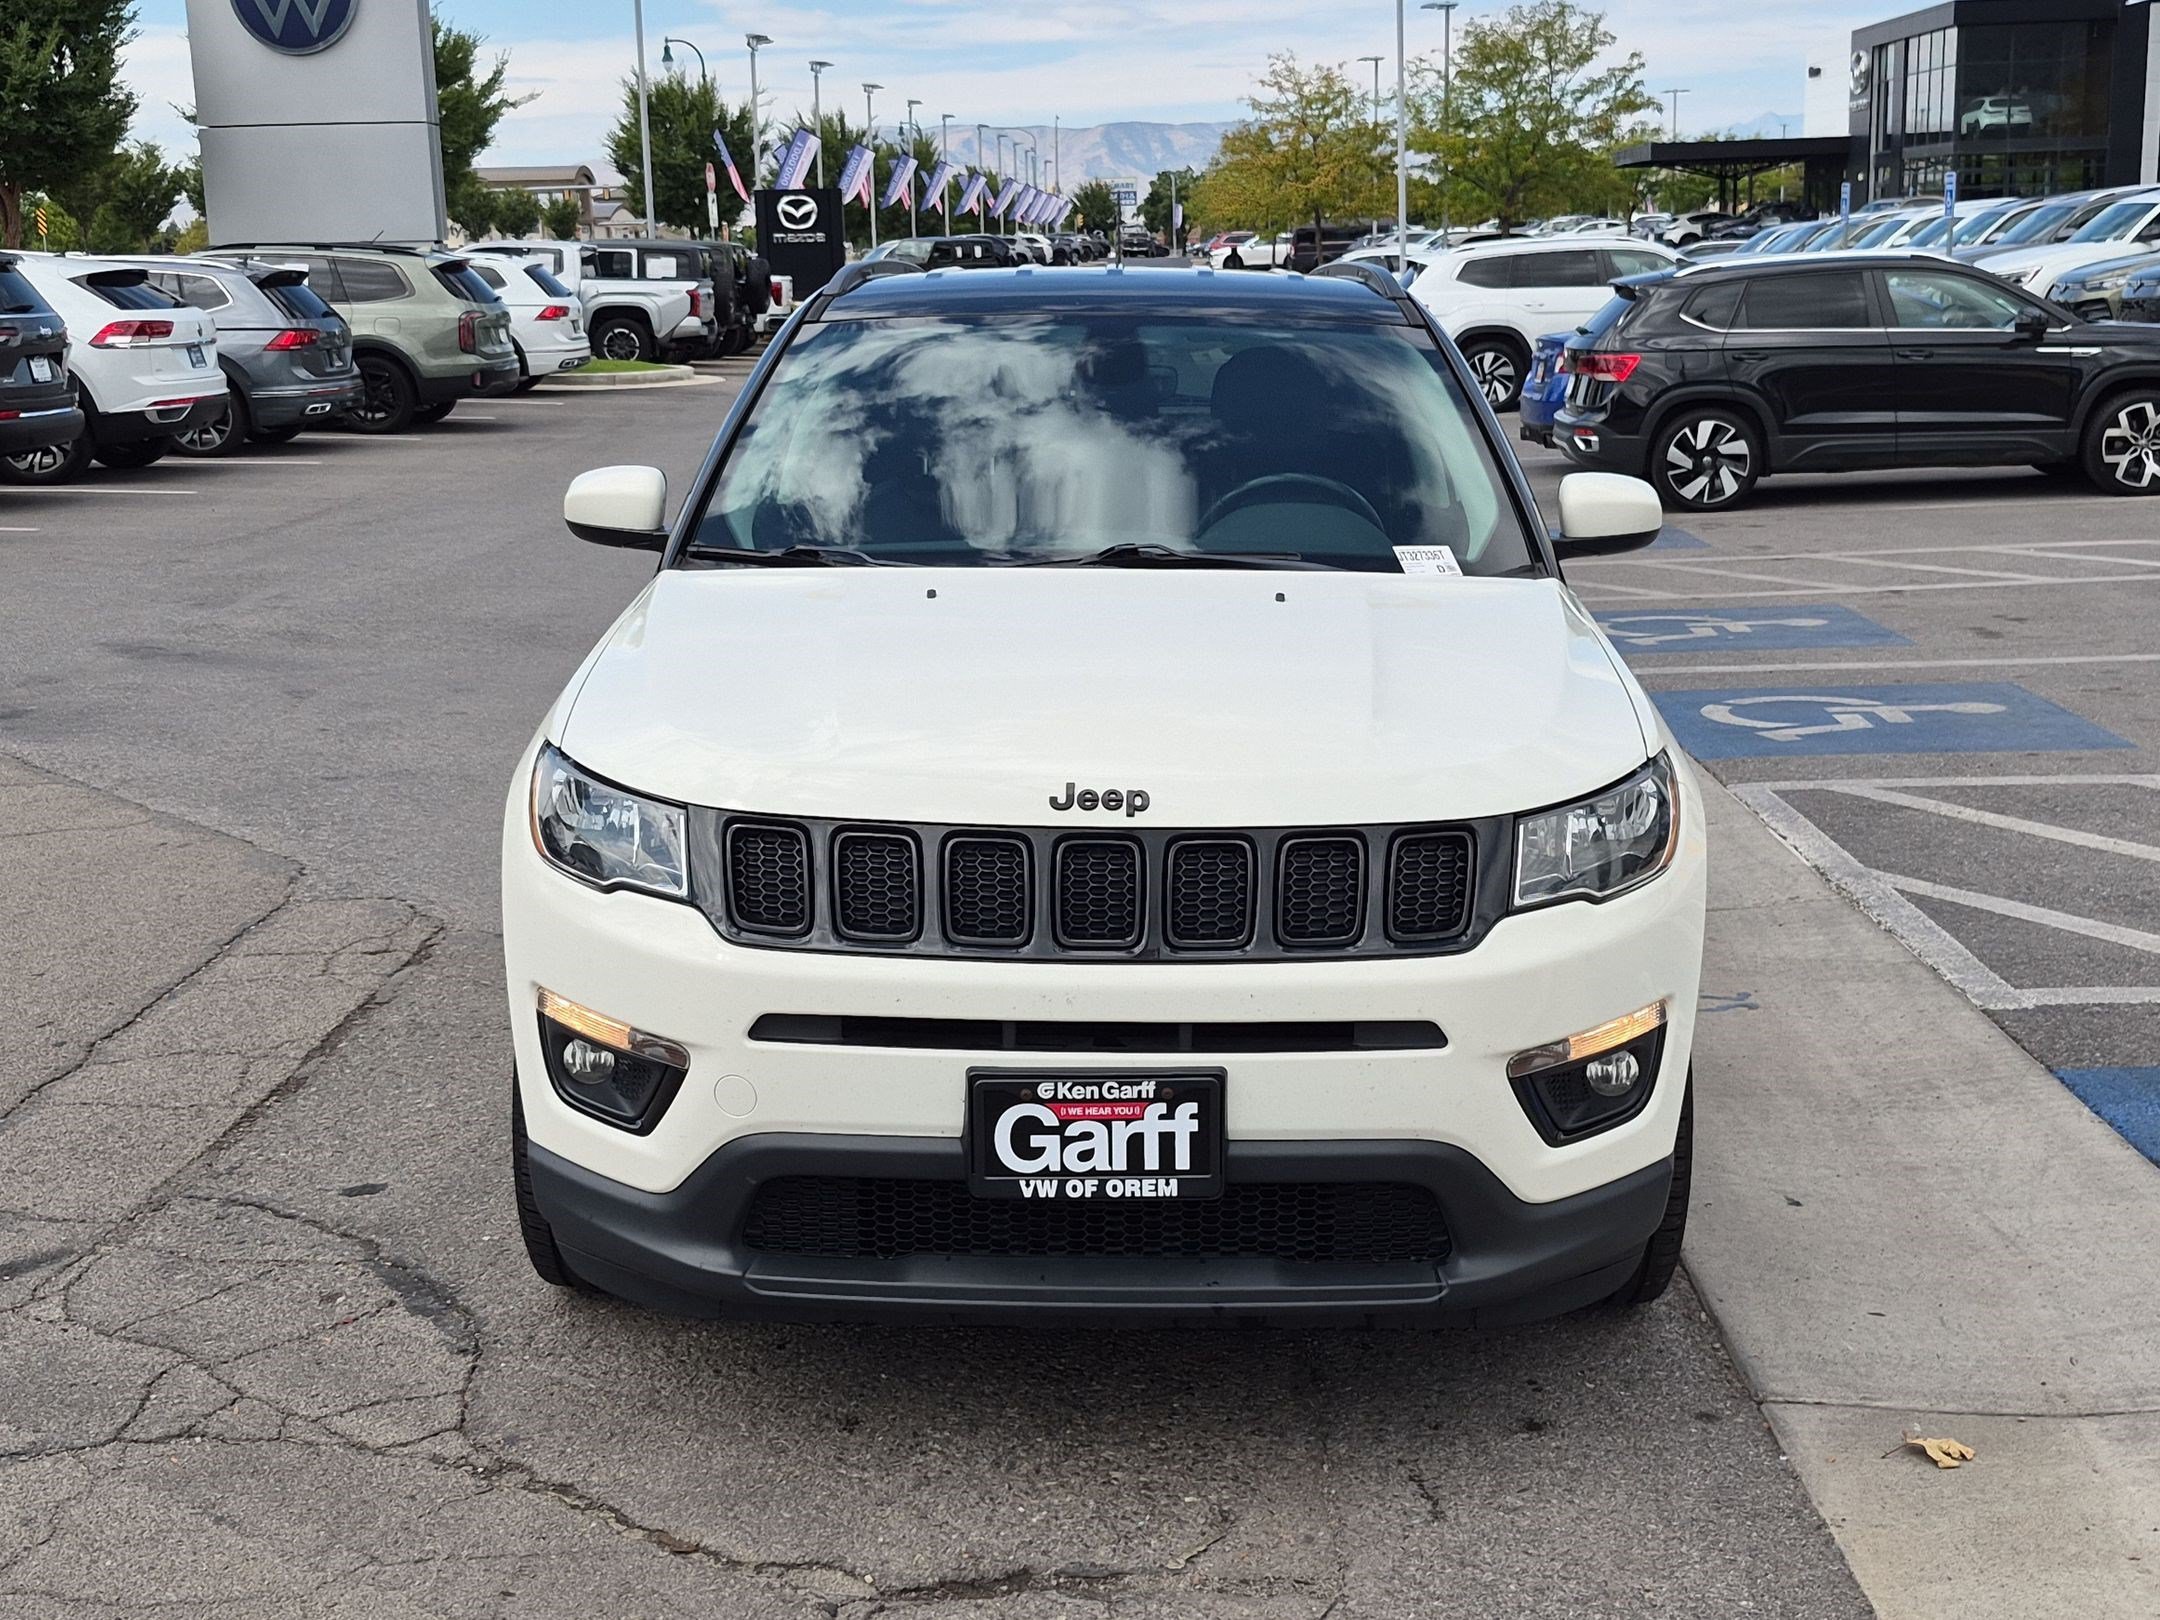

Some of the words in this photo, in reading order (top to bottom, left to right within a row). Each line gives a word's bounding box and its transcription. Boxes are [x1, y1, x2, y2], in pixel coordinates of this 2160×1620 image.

[772, 232, 826, 243] mazda
[1049, 782, 1150, 818] Jeep
[1057, 1082, 1099, 1099] Ken
[1102, 1081, 1157, 1099] Garff
[1068, 1107, 1083, 1115] WE
[1085, 1107, 1112, 1115] HEAR
[1113, 1106, 1133, 1115] YOU
[994, 1102, 1199, 1173] Garff
[1019, 1179, 1059, 1198] VW
[1065, 1179, 1099, 1198] OF
[1105, 1178, 1179, 1197] OREM
